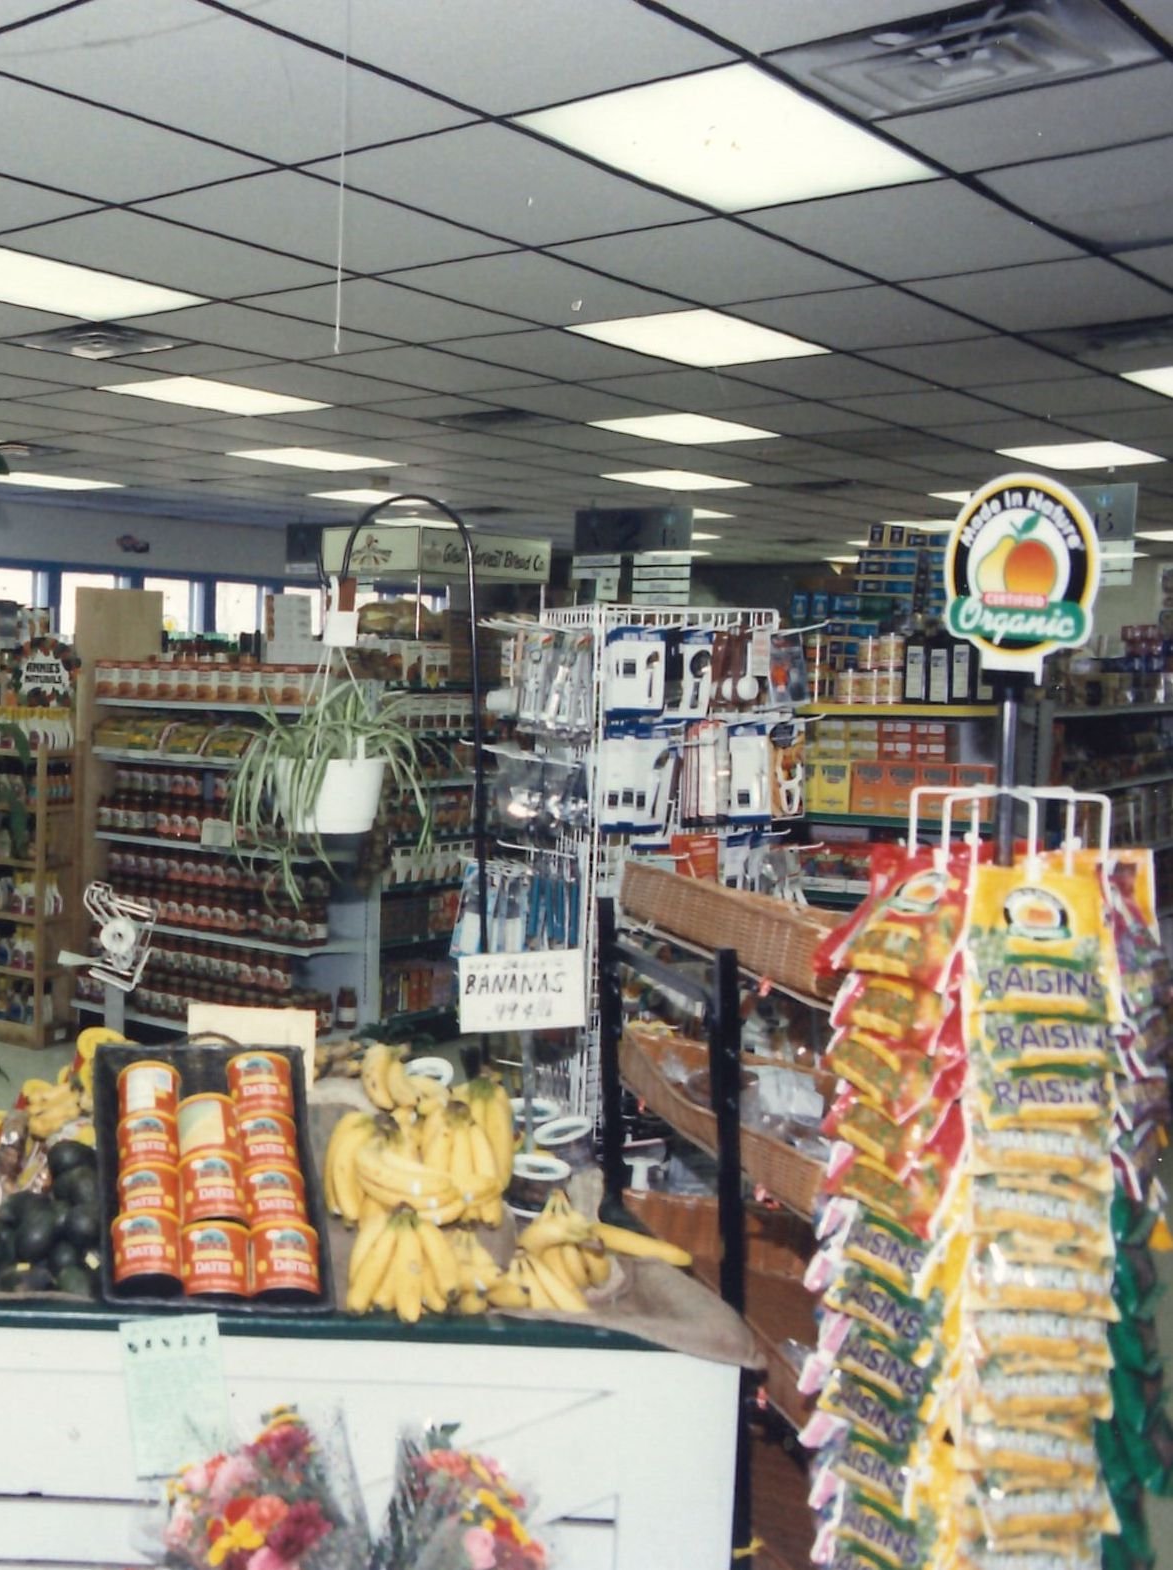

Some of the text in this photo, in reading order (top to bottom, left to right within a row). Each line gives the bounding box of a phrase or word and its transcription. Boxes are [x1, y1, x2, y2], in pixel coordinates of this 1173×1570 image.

[961, 498, 1002, 549] Made
[1004, 490, 1023, 508] In
[958, 599, 1076, 646] Organic
[465, 972, 567, 996] BANANAS
[987, 966, 1105, 1000] RAISINS
[998, 1023, 1118, 1050] RAISINS
[242, 1084, 278, 1096] DATES
[994, 1078, 1112, 1105] RAISINS
[132, 1141, 167, 1153] DATES
[249, 1144, 285, 1156] DATES
[198, 1187, 235, 1200] DATES
[127, 1198, 162, 1211] DATES
[258, 1199, 295, 1211] DATES
[126, 1246, 164, 1259] DATES
[194, 1261, 231, 1274] DATES
[273, 1260, 311, 1274] DATES
